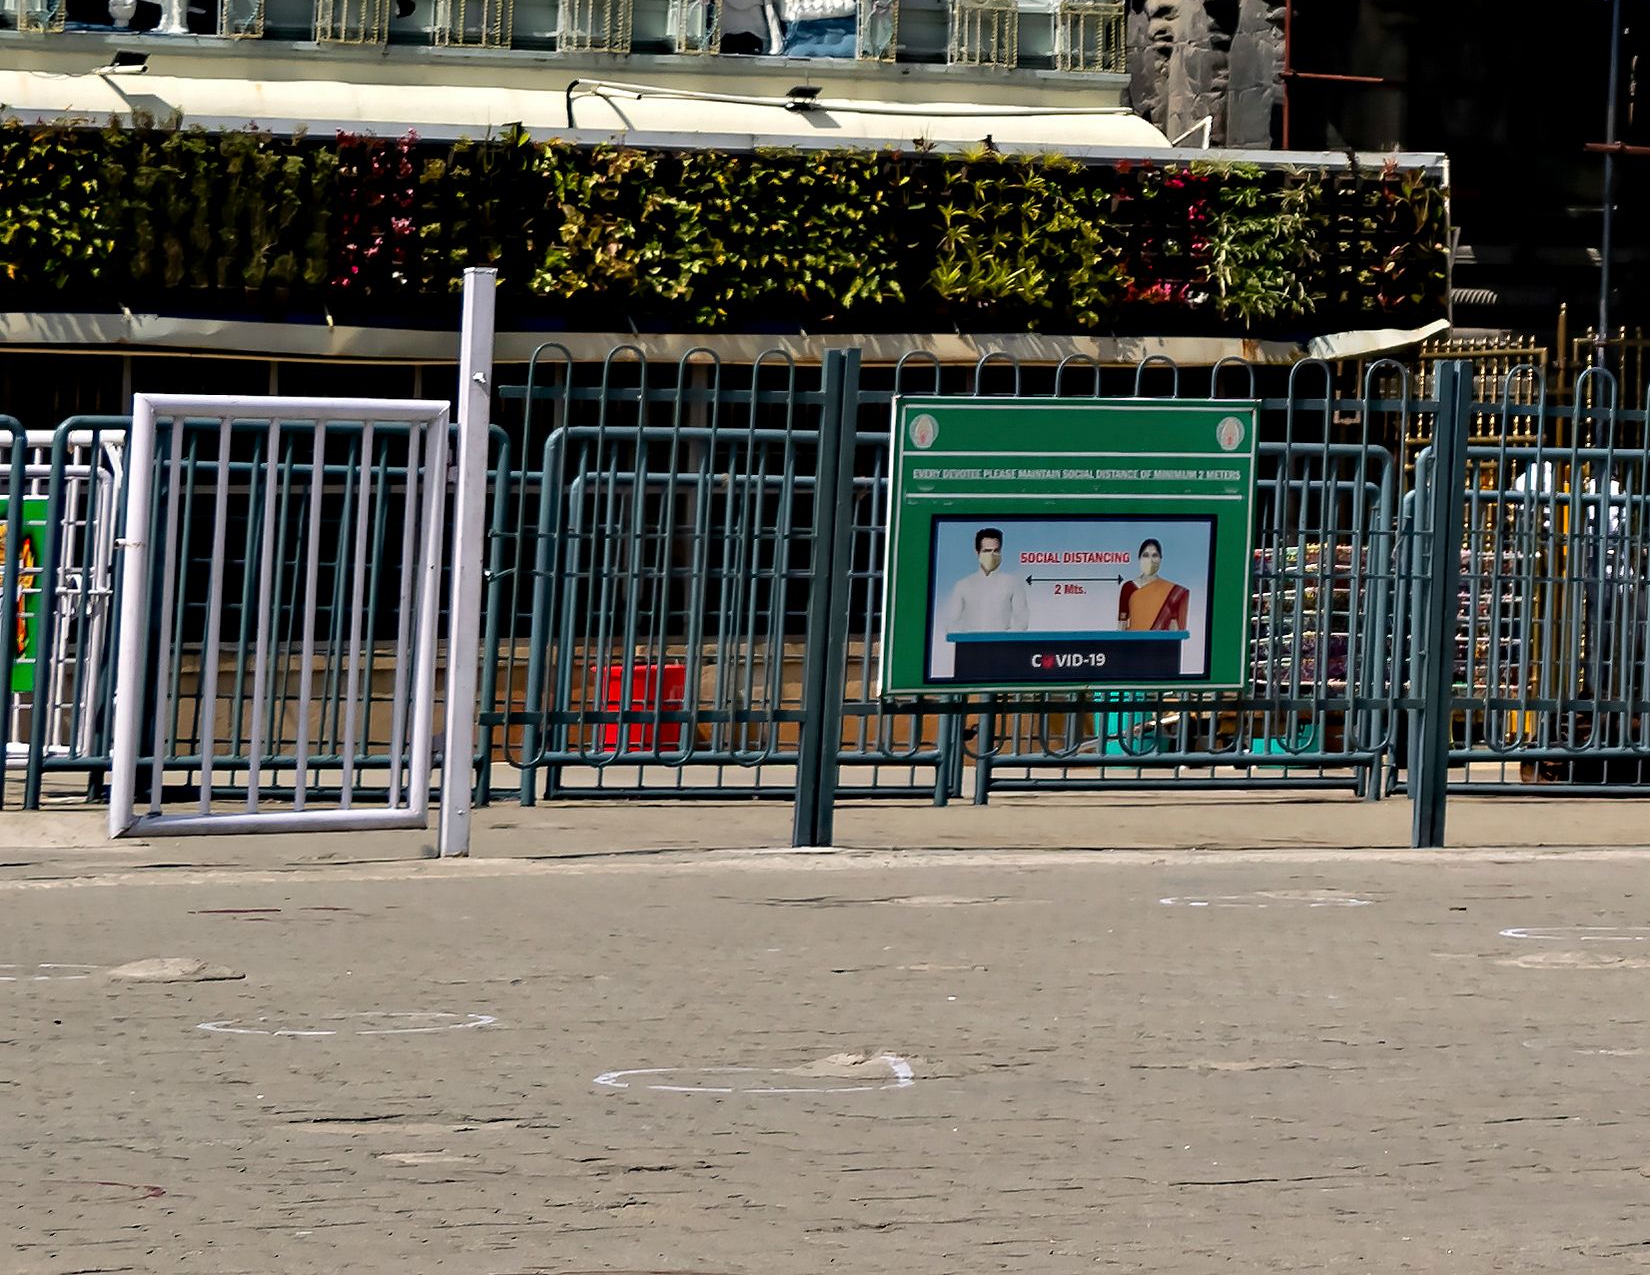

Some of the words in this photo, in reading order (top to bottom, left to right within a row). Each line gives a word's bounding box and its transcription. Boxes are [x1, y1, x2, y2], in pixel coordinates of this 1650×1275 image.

[912, 469, 940, 480] EVERY
[984, 469, 1016, 480] PLEASE
[1018, 469, 1061, 480] MAINTAIN
[1062, 469, 1094, 480] SOCIAL
[1096, 469, 1138, 480] DISTANCE
[1140, 469, 1152, 480] OF
[1206, 469, 1241, 480] METERS
[1020, 552, 1060, 563] SOCIAL
[1063, 552, 1130, 564] DISTANCING
[1054, 584, 1061, 595] 2
[1064, 584, 1087, 595] Mts.
